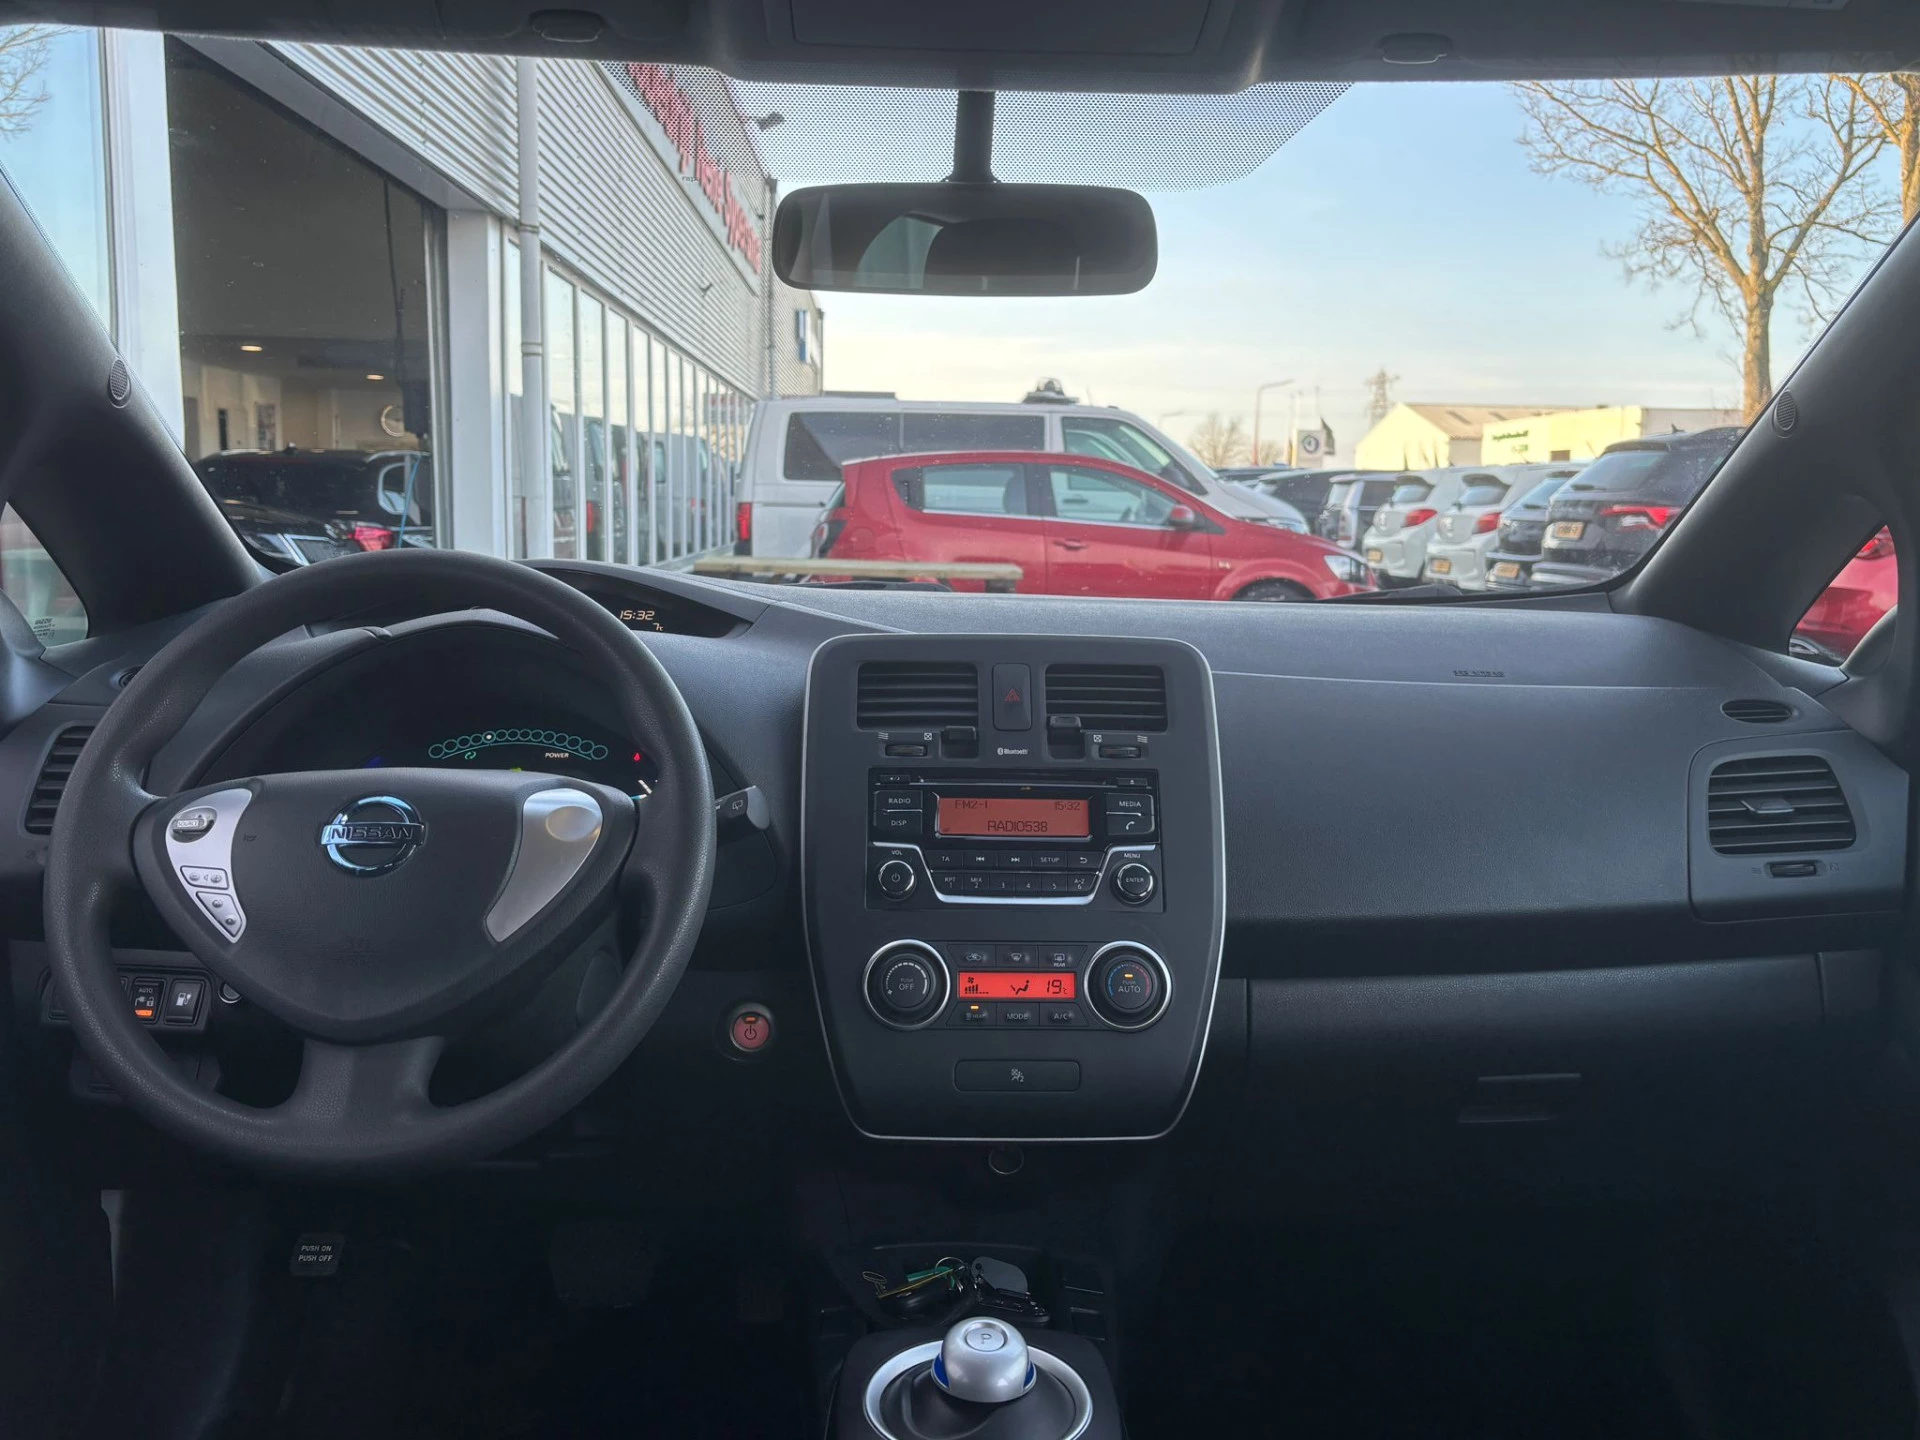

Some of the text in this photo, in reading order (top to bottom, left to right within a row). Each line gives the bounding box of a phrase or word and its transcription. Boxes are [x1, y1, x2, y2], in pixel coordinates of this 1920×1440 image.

[620, 610, 655, 620] 15:32
[954, 800, 1081, 811] FM2-1 15:32
[987, 820, 1048, 832] RADIO538
[331, 825, 414, 840] NISSAN
[899, 983, 914, 991] OFF
[1118, 985, 1141, 993] AUTO
[980, 1333, 992, 1344] P
